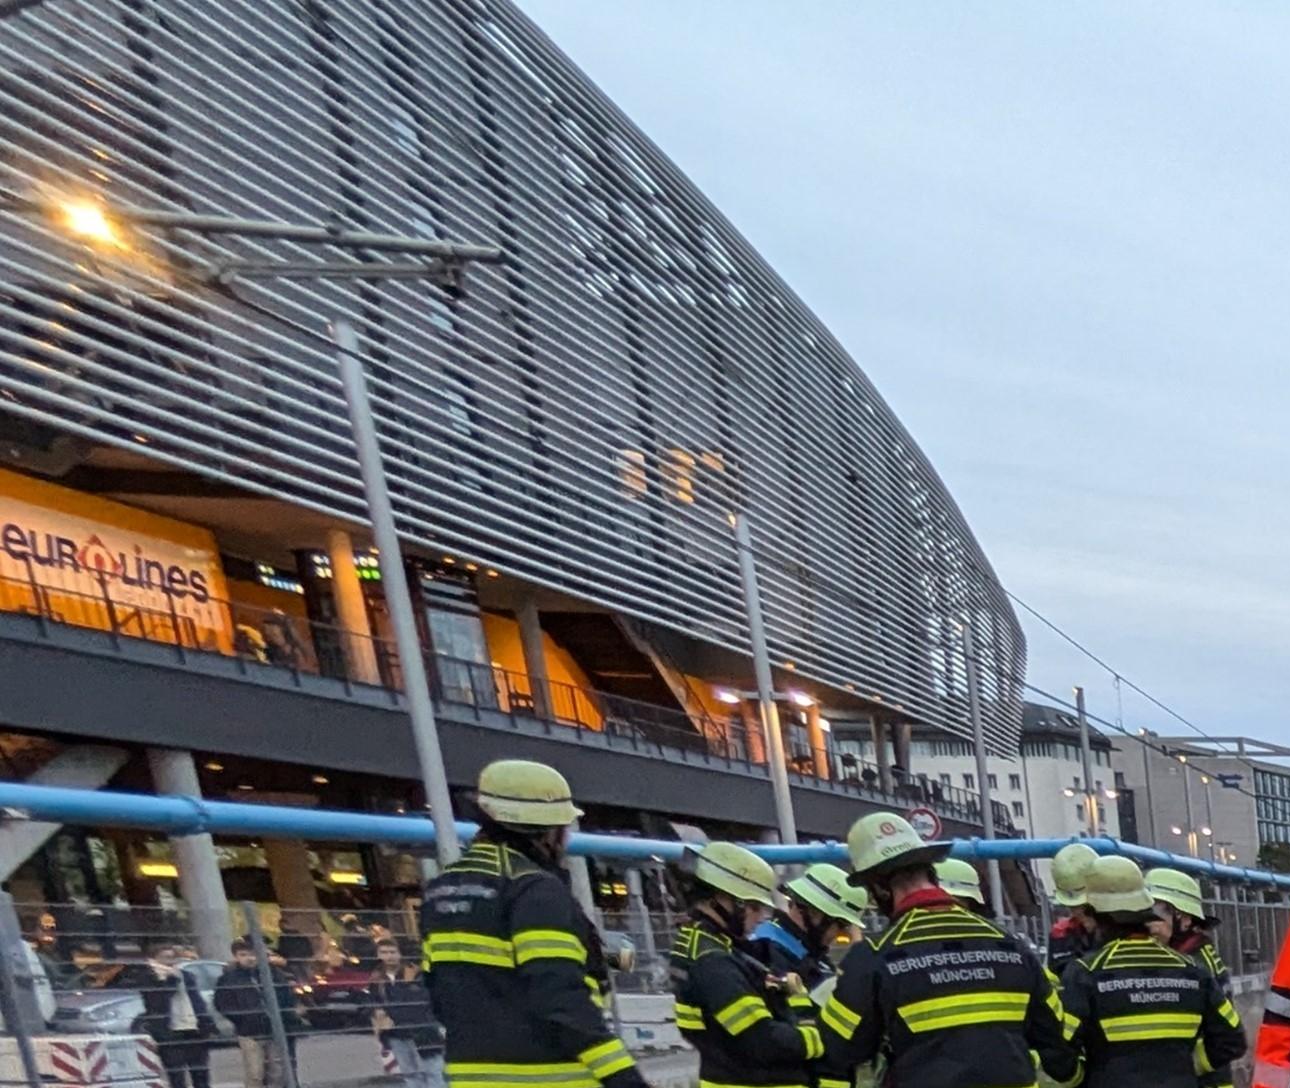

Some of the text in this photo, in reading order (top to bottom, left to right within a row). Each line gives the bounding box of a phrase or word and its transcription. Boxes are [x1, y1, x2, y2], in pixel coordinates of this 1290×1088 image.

[887, 950, 1023, 976] BERUFSFEUERWEHR
[929, 967, 996, 985] MÜNCHEN
[1097, 977, 1200, 993] BERUFSFEUERWEHR
[1129, 991, 1180, 1003] MÜNCHEN
